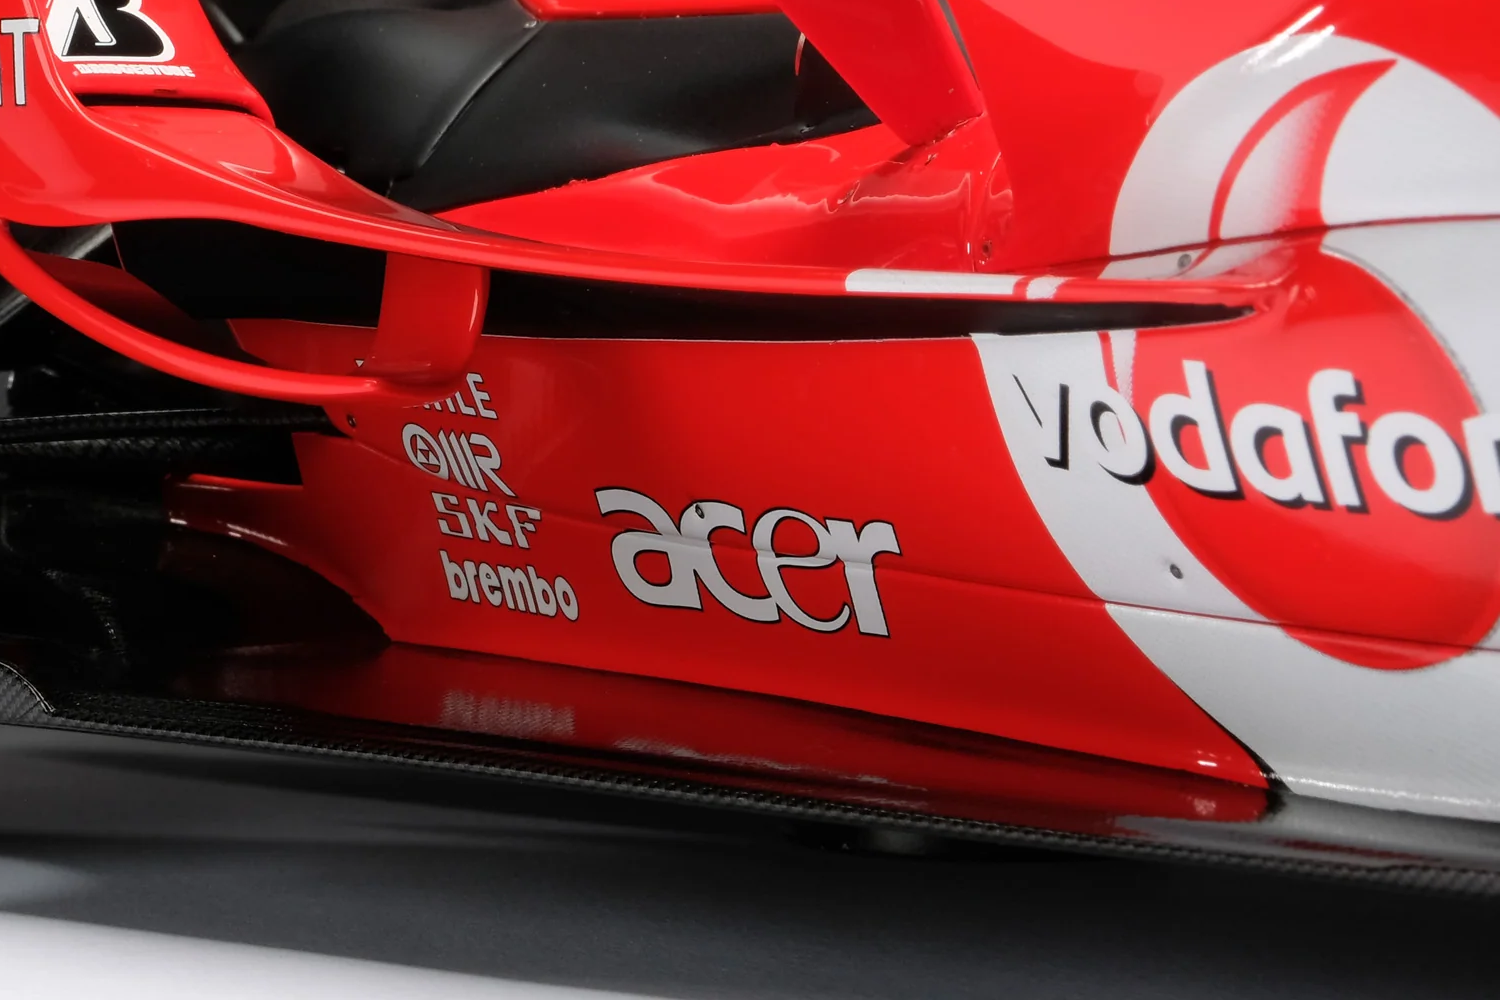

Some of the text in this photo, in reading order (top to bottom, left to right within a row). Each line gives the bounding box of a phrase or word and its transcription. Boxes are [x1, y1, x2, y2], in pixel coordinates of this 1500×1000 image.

[430, 492, 542, 549] SKF
[439, 550, 580, 622] brembo
[594, 486, 902, 638] acer
